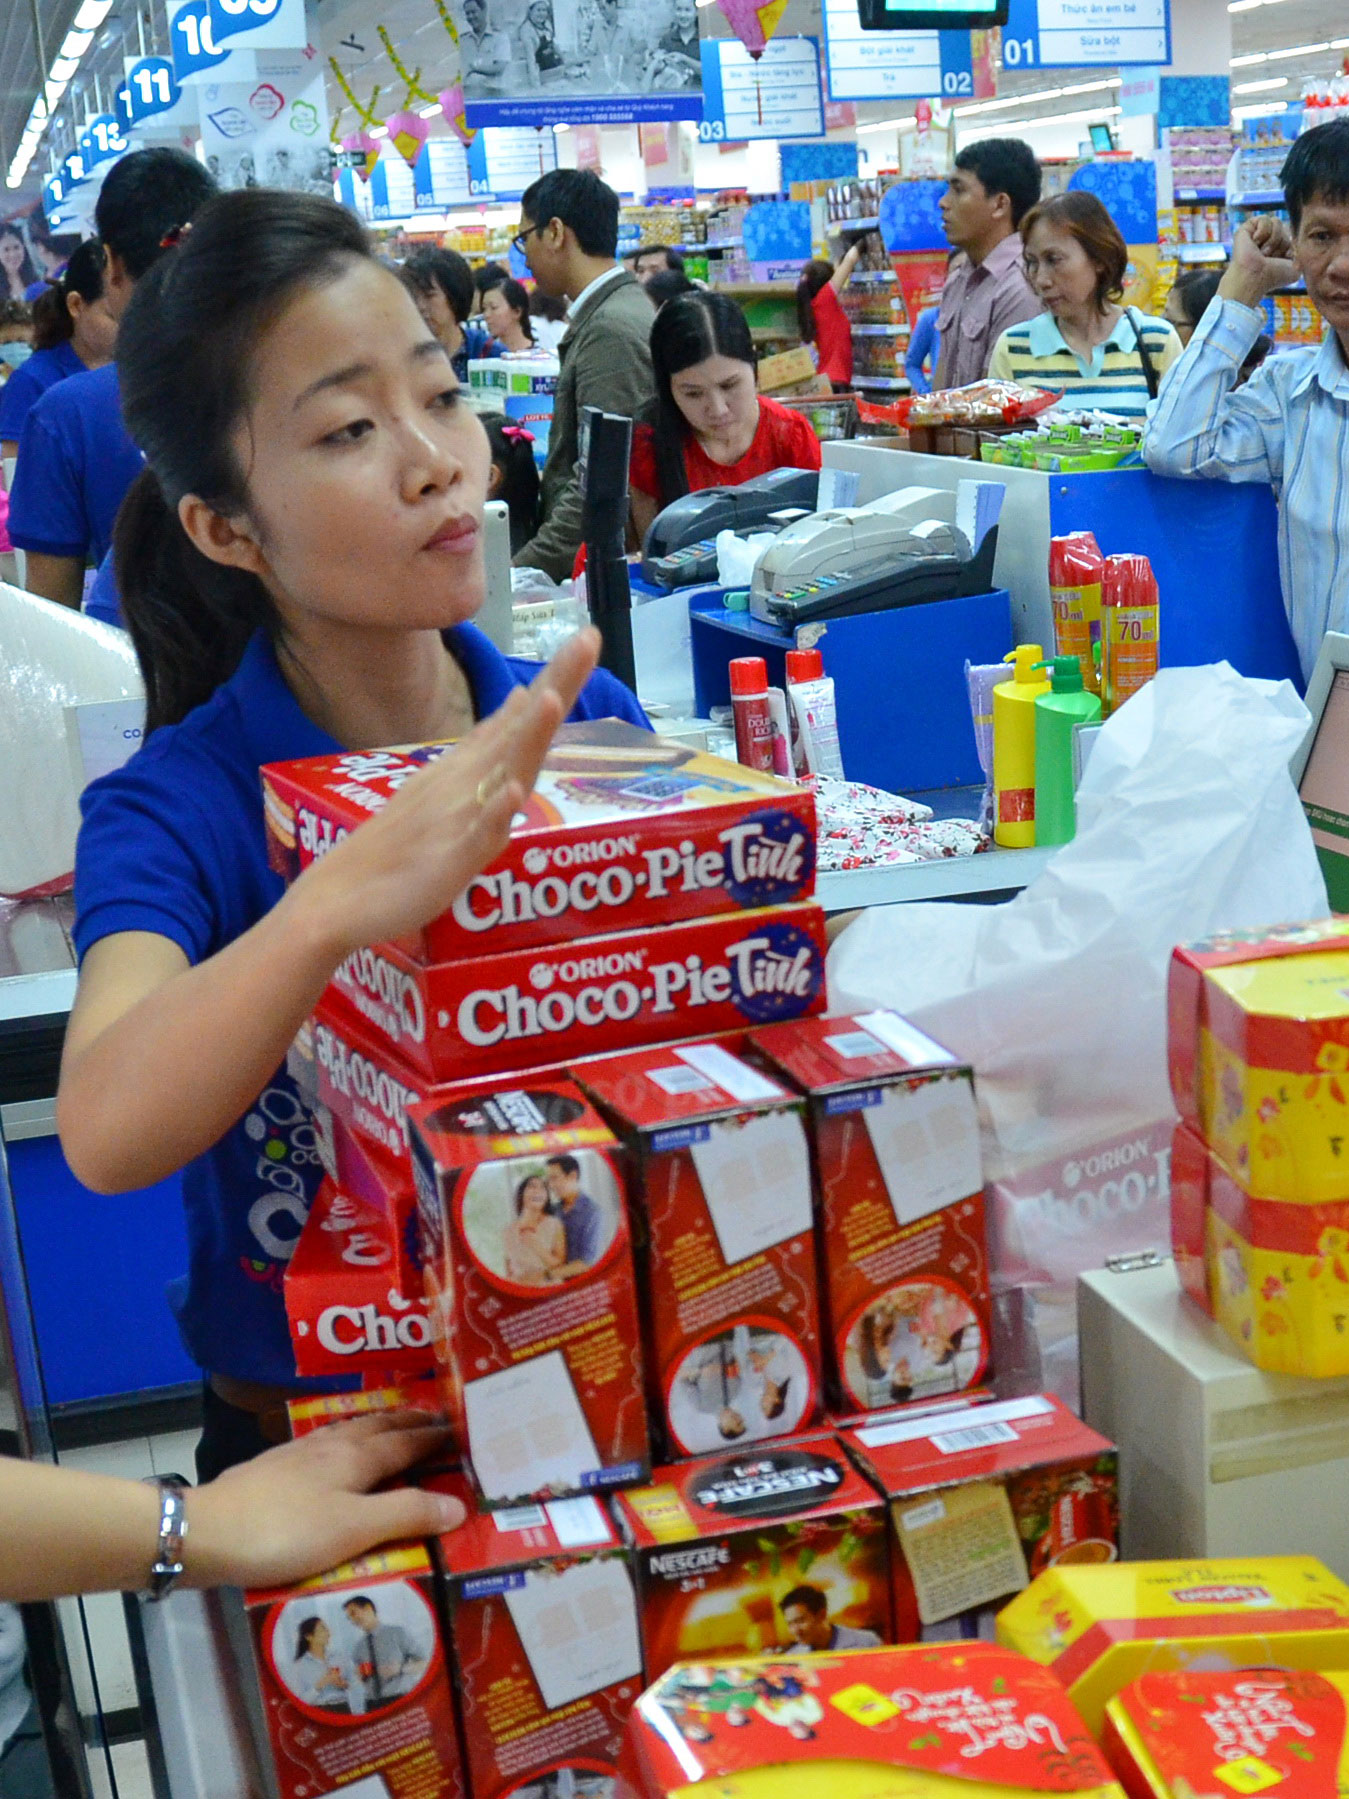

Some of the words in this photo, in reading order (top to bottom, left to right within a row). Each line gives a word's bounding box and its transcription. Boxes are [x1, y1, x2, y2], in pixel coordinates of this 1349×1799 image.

[1004, 39, 1034, 65] 01
[133, 68, 171, 103] 11
[943, 71, 972, 93] 02
[699, 120, 725, 140] 03
[416, 193, 434, 205] 05
[471, 179, 488, 193] 04
[552, 836, 637, 868] ORION
[558, 951, 643, 982] ORION
[1083, 1138, 1150, 1177] ORION
